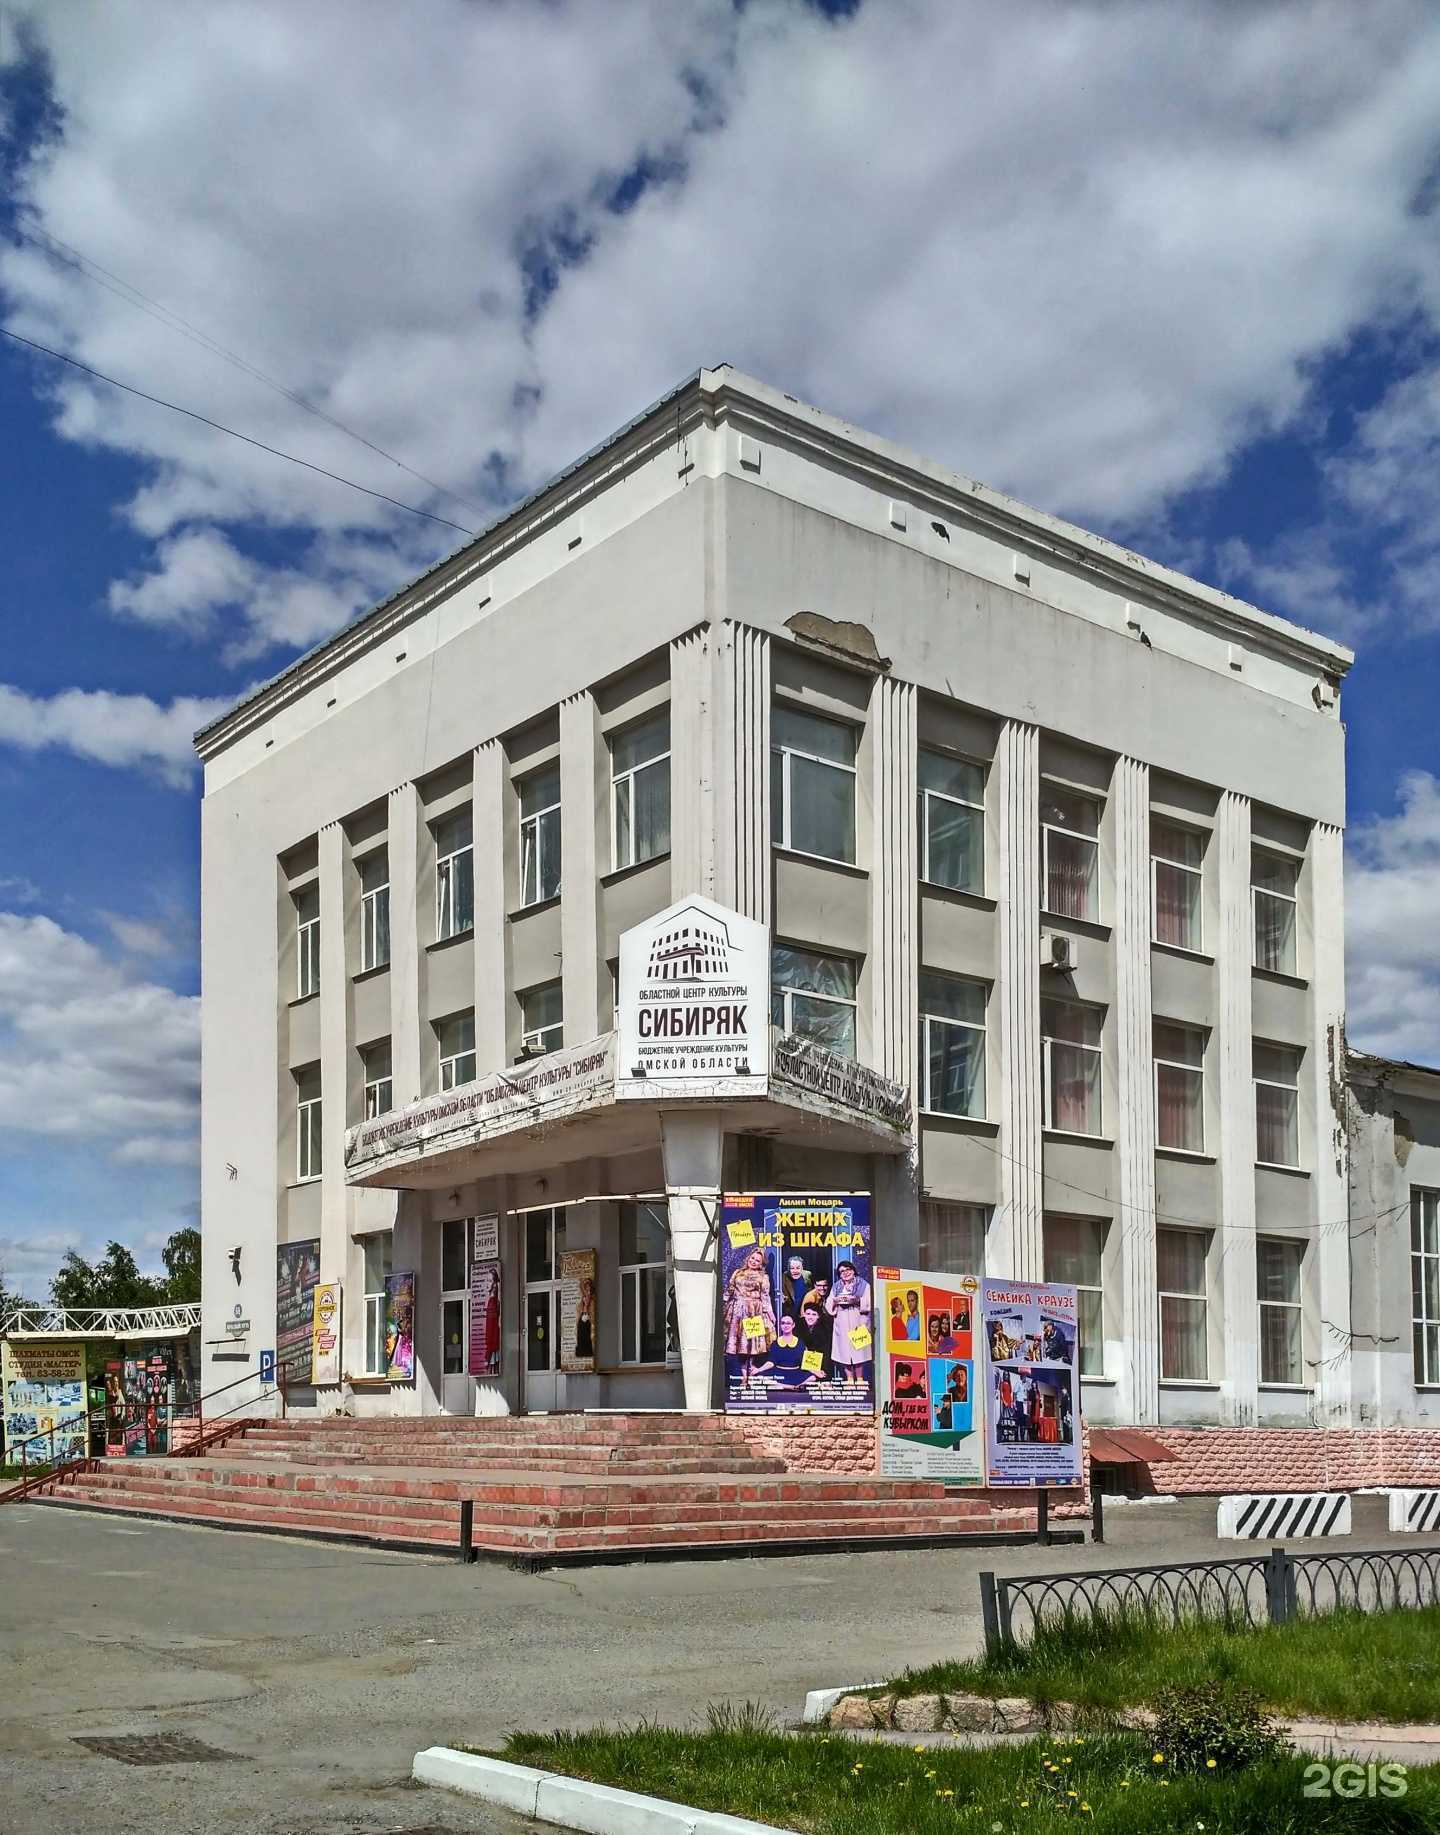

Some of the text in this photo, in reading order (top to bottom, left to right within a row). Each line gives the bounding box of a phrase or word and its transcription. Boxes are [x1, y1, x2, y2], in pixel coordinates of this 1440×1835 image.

[639, 986, 748, 1000] ОБЛАСТНОЙ ЦЕНТР КУЛЬТУРЫ
[638, 1005, 748, 1038] СИБИРЯК
[638, 1044, 748, 1056] БЮДЖЕТНОЕ УЧРЕЖДЕНИЕ КУЛЬТУРЫ
[638, 1057, 748, 1070] ОМСКОЙ ОБЛАСТИ
[459, 1090, 483, 1112] ОБЛАСТИ
[520, 1075, 539, 1096] ЦЕНТР
[539, 1064, 572, 1089] КУЛЬТУРЫ
[573, 1050, 608, 1075] "СИБИРЯК"
[779, 1198, 844, 1207] Лилия Моцарь
[774, 1212, 847, 1227] ЖЕНИХ
[758, 1232, 865, 1247] ИЗ ШКАФА
[986, 1289, 1075, 1308] СЕМЕЙКА КРАУЗЕ
[9, 1350, 80, 1358] ШАХМАТЫ ОМСК
[8, 1361, 42, 1369] СТУДИЯ
[882, 1401, 905, 1416] ДОМ,
